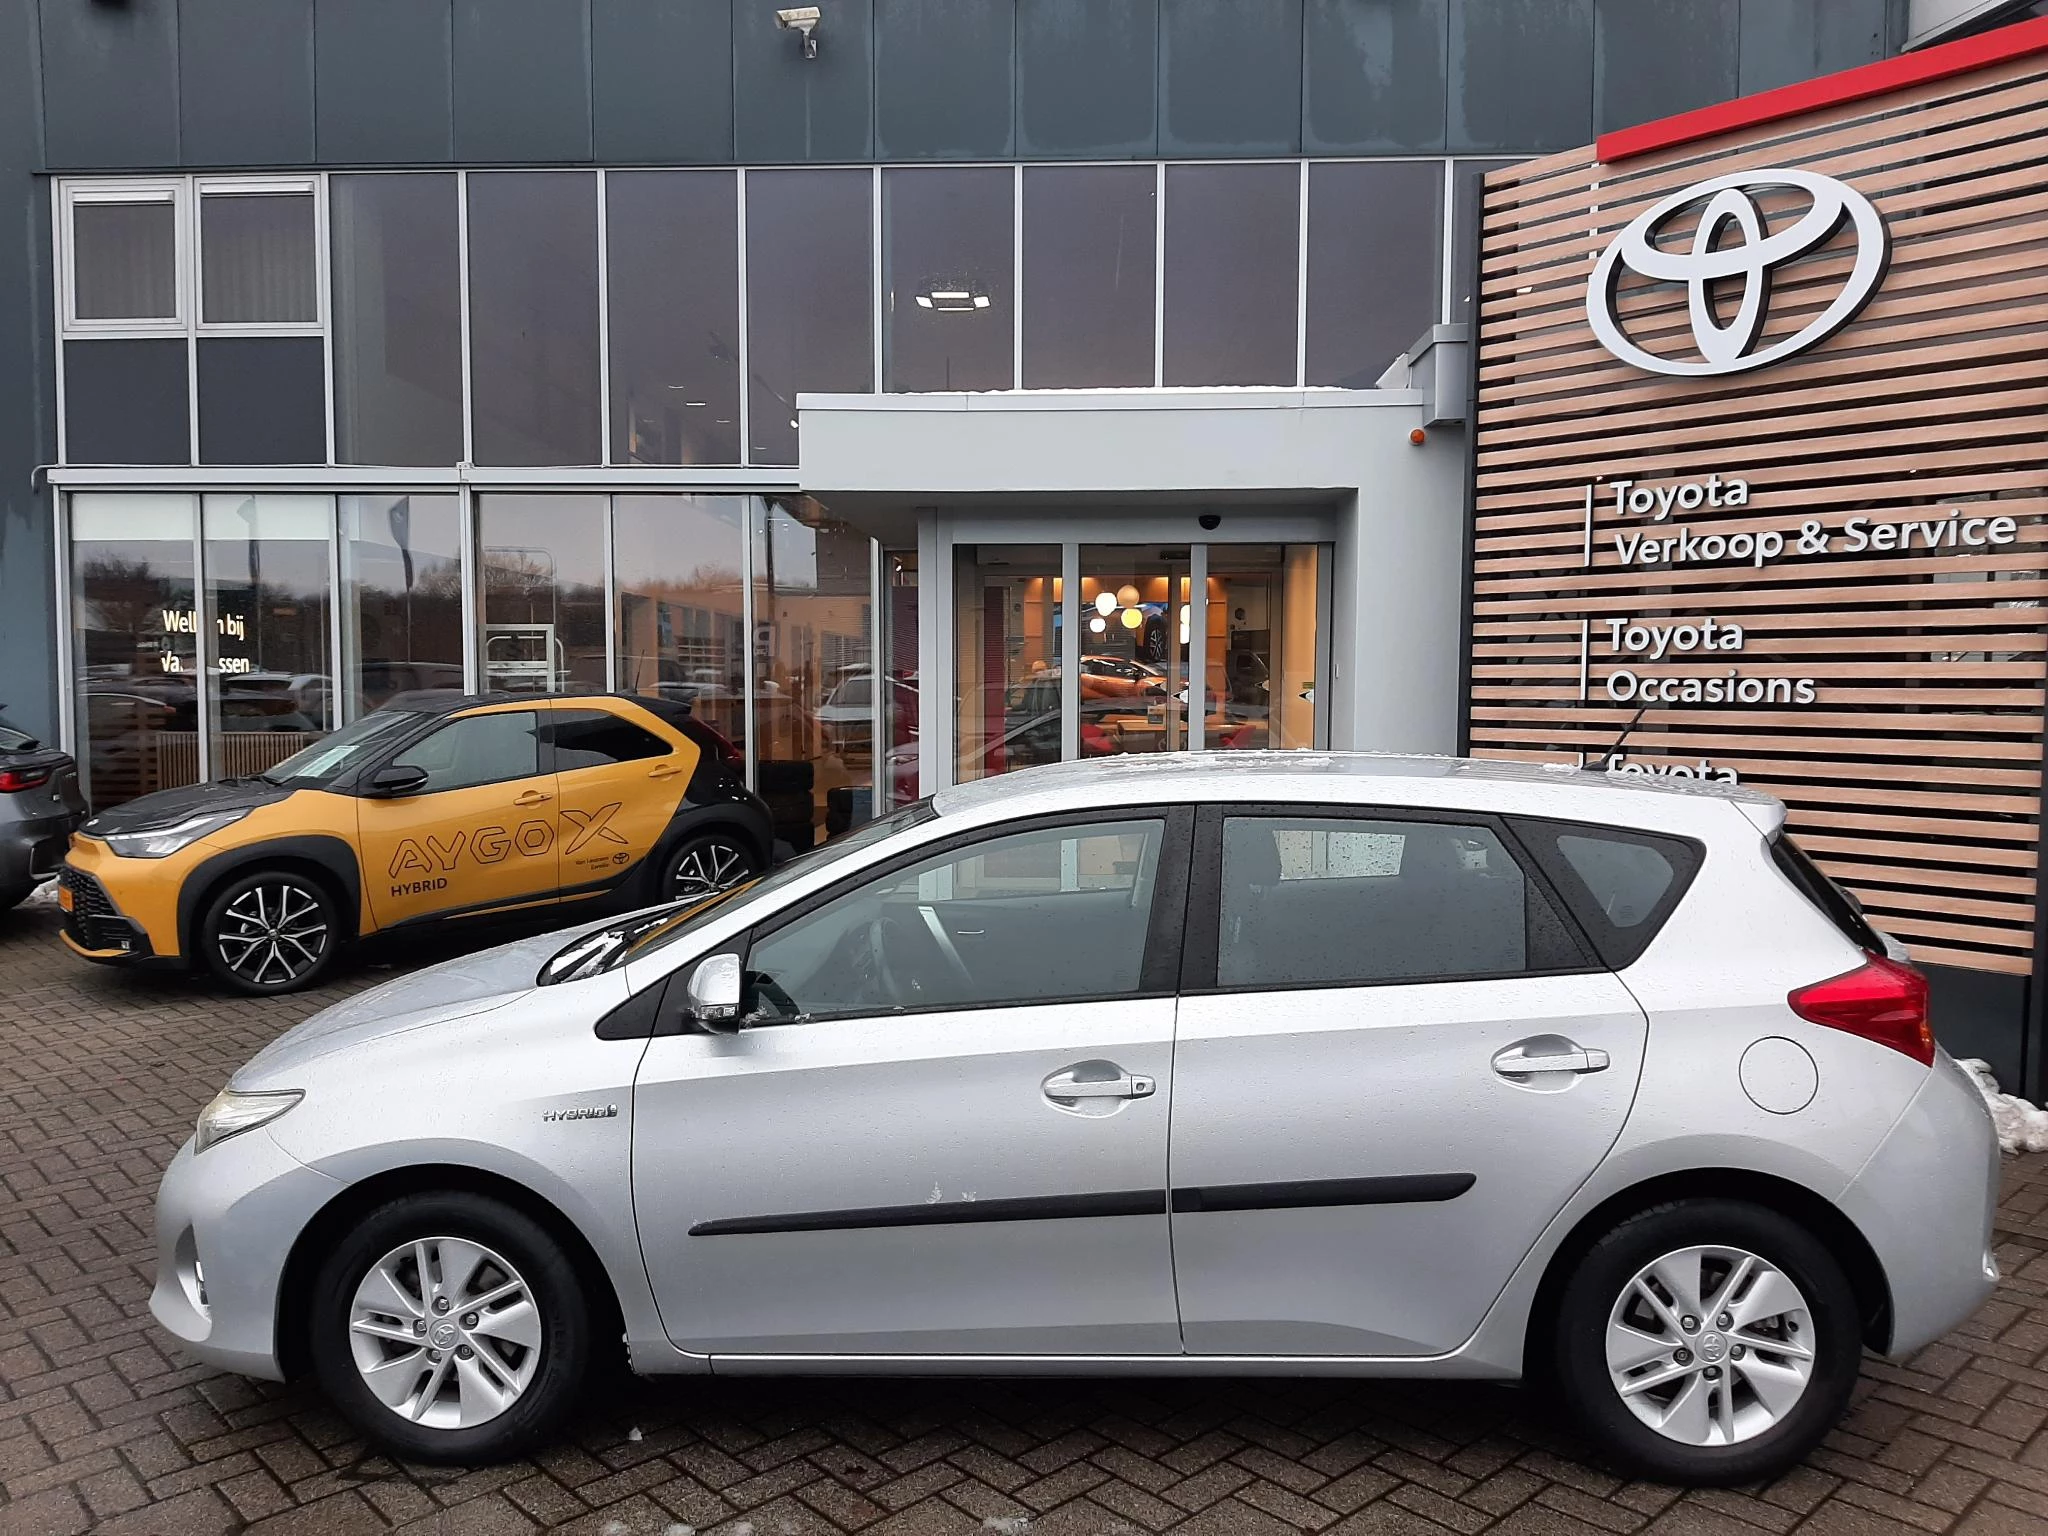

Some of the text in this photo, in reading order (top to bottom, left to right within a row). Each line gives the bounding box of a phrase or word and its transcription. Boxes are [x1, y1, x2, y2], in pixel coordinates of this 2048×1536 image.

[1610, 474, 1749, 521] Toyota
[1615, 509, 2017, 568] Verkoop & Service
[227, 613, 244, 641] bij
[1606, 617, 1744, 660] Toyota
[160, 650, 184, 673] Va
[1607, 669, 1816, 704] Occasions
[391, 877, 448, 897] HYBRID
[543, 1106, 607, 1122] HYBRID
